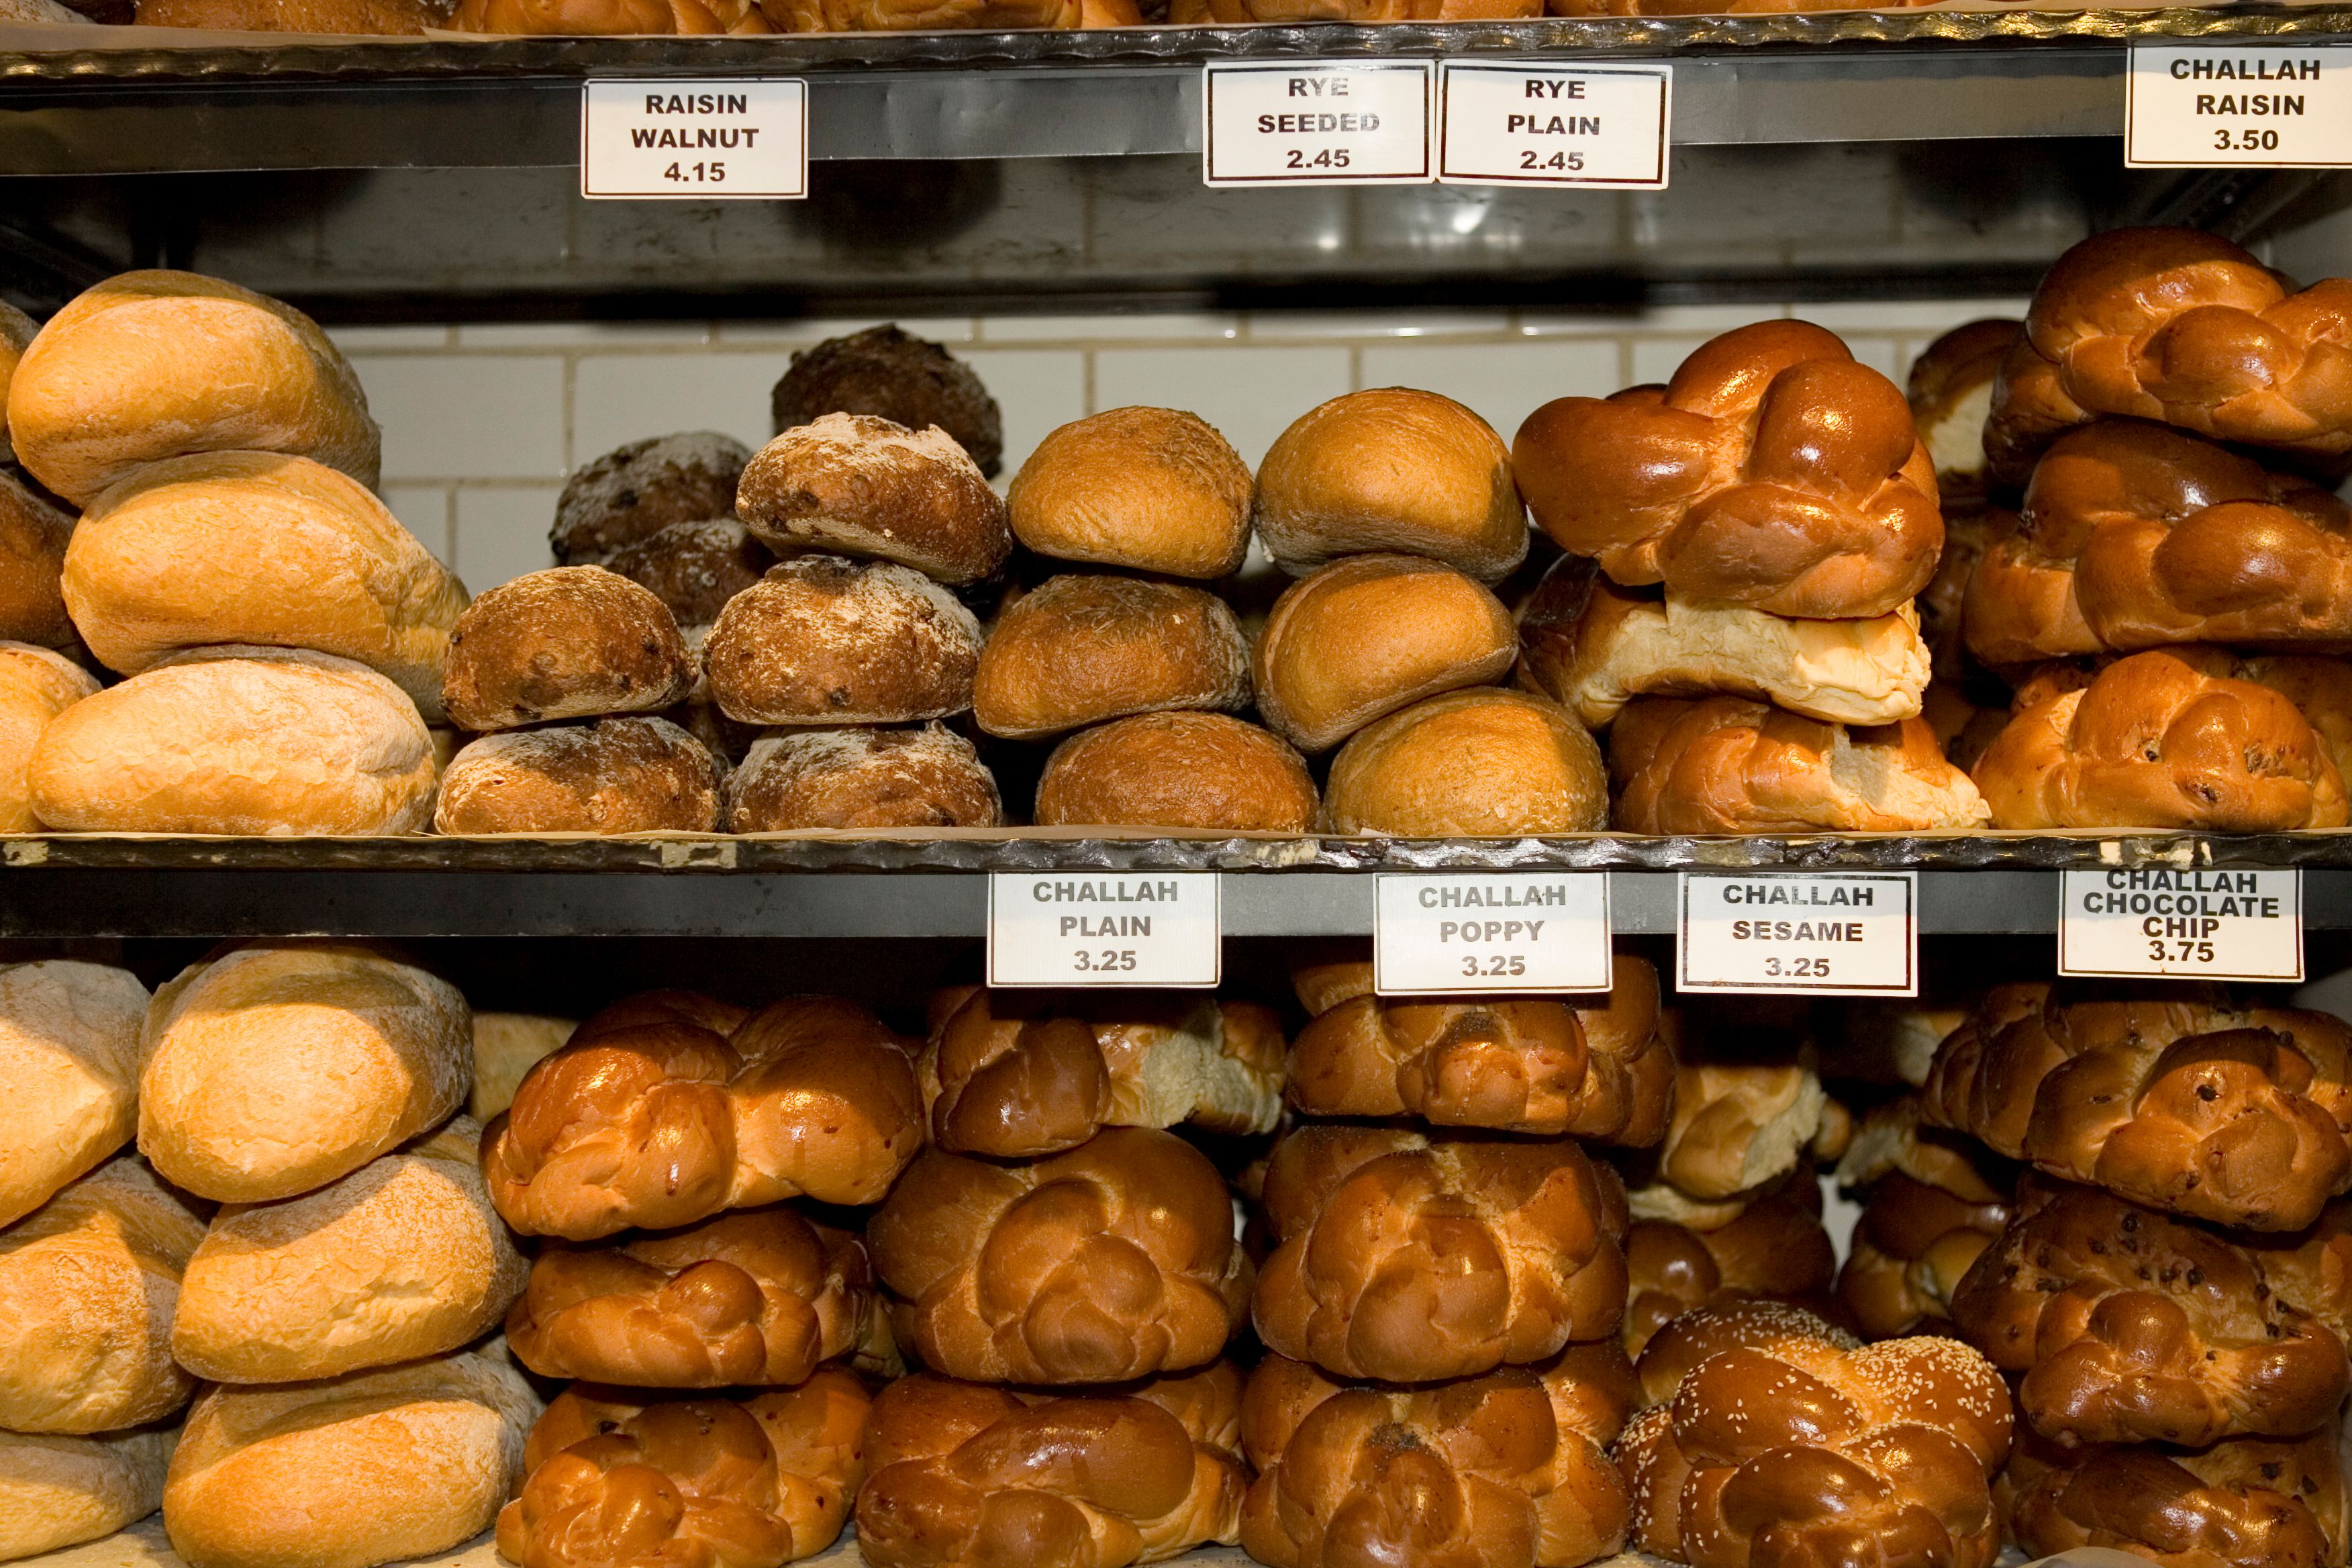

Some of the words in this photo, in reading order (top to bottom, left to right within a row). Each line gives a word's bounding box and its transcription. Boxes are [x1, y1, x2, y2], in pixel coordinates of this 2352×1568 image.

[2169, 58, 2320, 80] CHALLAH
[1288, 77, 1349, 97] RYE
[1524, 79, 1585, 99] RYE
[645, 94, 747, 114] RAISIN
[2196, 95, 2304, 115] RAISIN
[1257, 112, 1380, 134] SEEDED
[1507, 114, 1600, 136] PLAIN
[630, 128, 760, 148] WALNUT
[2213, 129, 2279, 150] 3.50
[1286, 148, 1351, 168] 2.45
[1519, 150, 1584, 170] 2.45
[664, 162, 726, 182] 4.15
[1032, 881, 1178, 902] CHALLAH
[2106, 869, 2257, 893] CHALLAH
[1418, 885, 1566, 908] CHALLAH
[1722, 884, 1873, 906] CHALLAH
[2083, 891, 2280, 918] CHOCOLATE
[1060, 916, 1150, 936] PLAIN
[1440, 920, 1545, 942] POPPY
[1732, 920, 1863, 942] SESAME
[2143, 916, 2220, 938] CHIP
[1074, 950, 1136, 971] 3.25
[2148, 940, 2214, 963] 3.75
[1461, 955, 1526, 977] 3.25
[1765, 957, 1830, 977] 3.25
